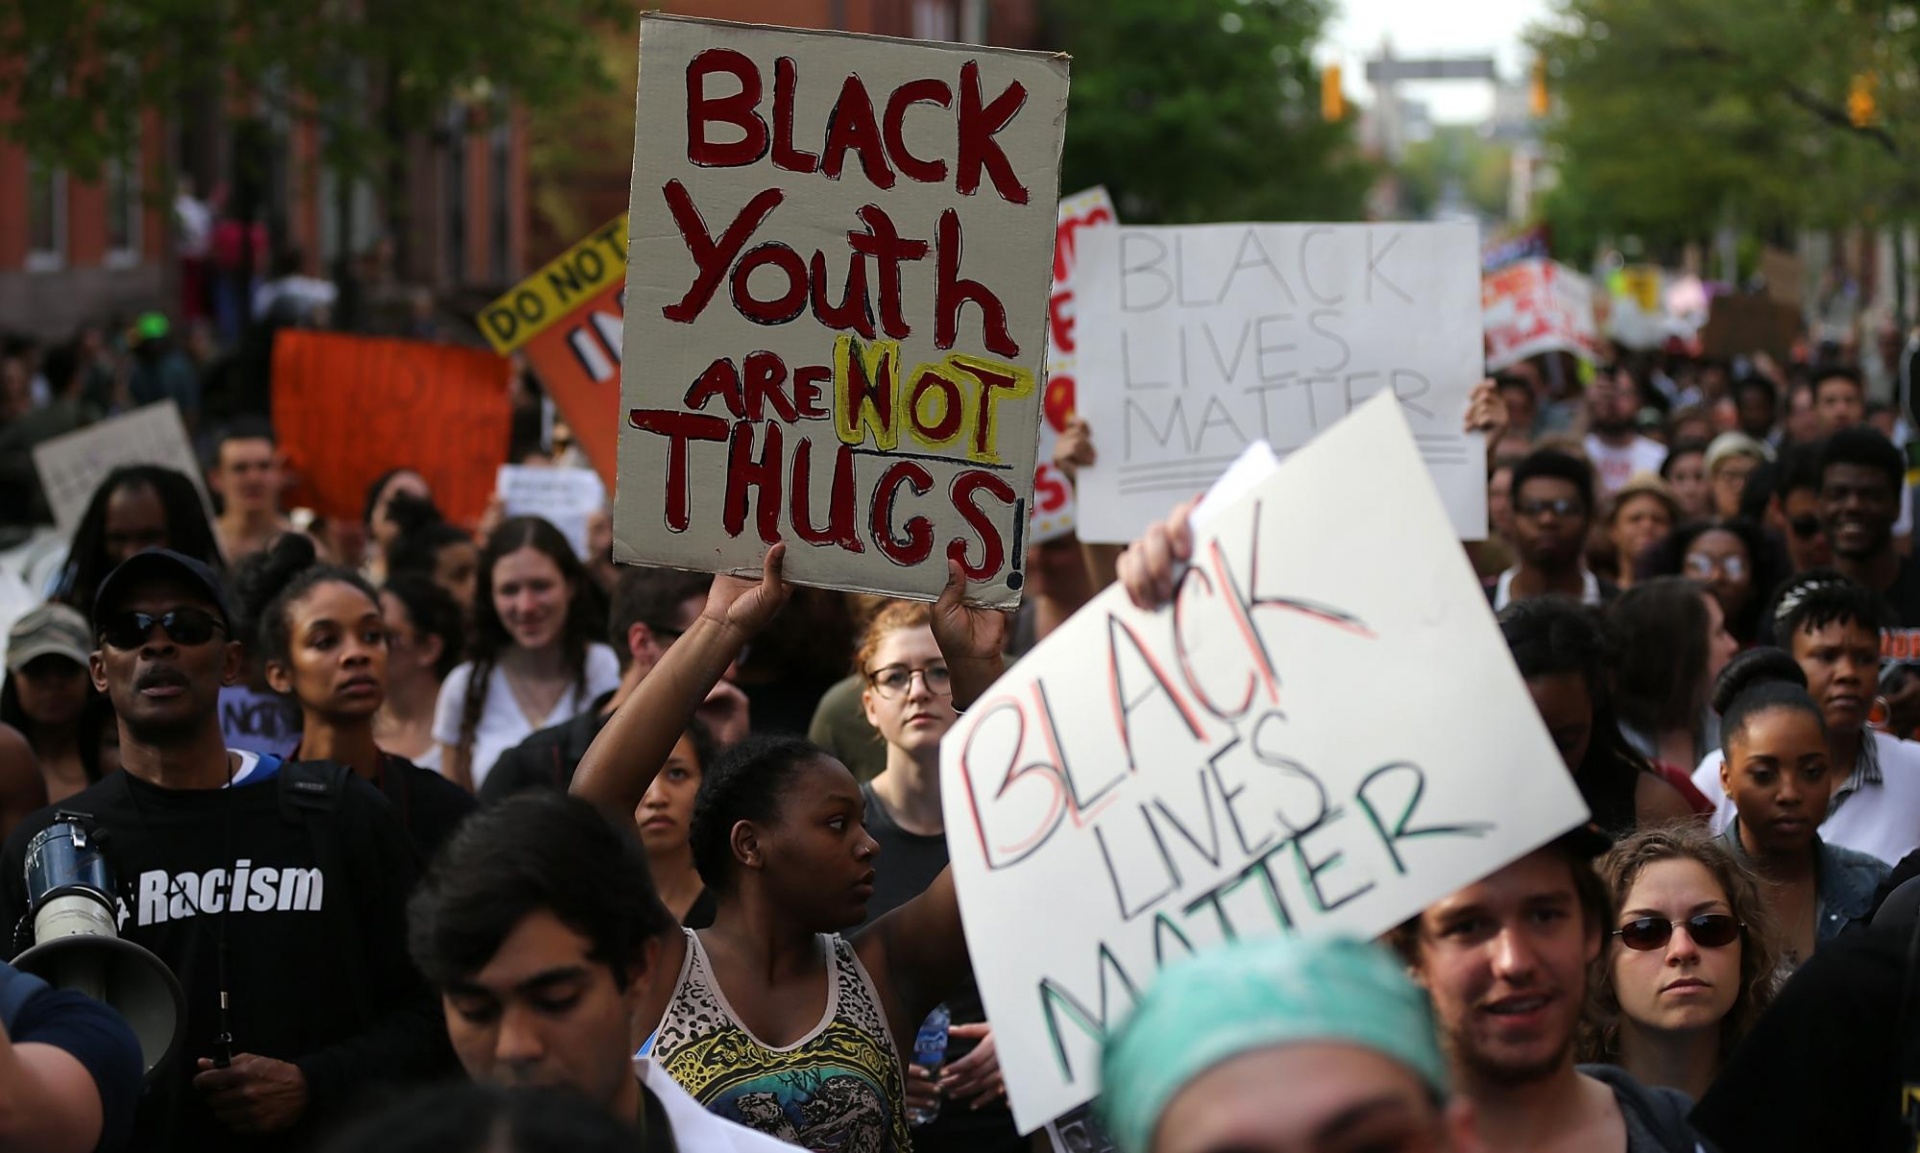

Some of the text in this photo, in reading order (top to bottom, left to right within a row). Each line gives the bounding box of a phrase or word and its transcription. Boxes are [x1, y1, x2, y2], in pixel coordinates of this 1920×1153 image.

[686, 47, 1030, 204] BLACK
[487, 223, 627, 344] DO NOT
[662, 178, 1019, 357] Youth
[1118, 227, 1414, 313] BLACK
[684, 350, 831, 424] ARE
[832, 333, 1033, 463] NOT
[1121, 309, 1351, 391] LIVES
[1124, 369, 1436, 462] MATTER
[629, 409, 1024, 589] THUGS!
[959, 499, 1379, 872] BLACK
[1093, 709, 1331, 921] LIVES
[138, 859, 324, 927] Racism
[1037, 762, 1497, 1085] MATTER
